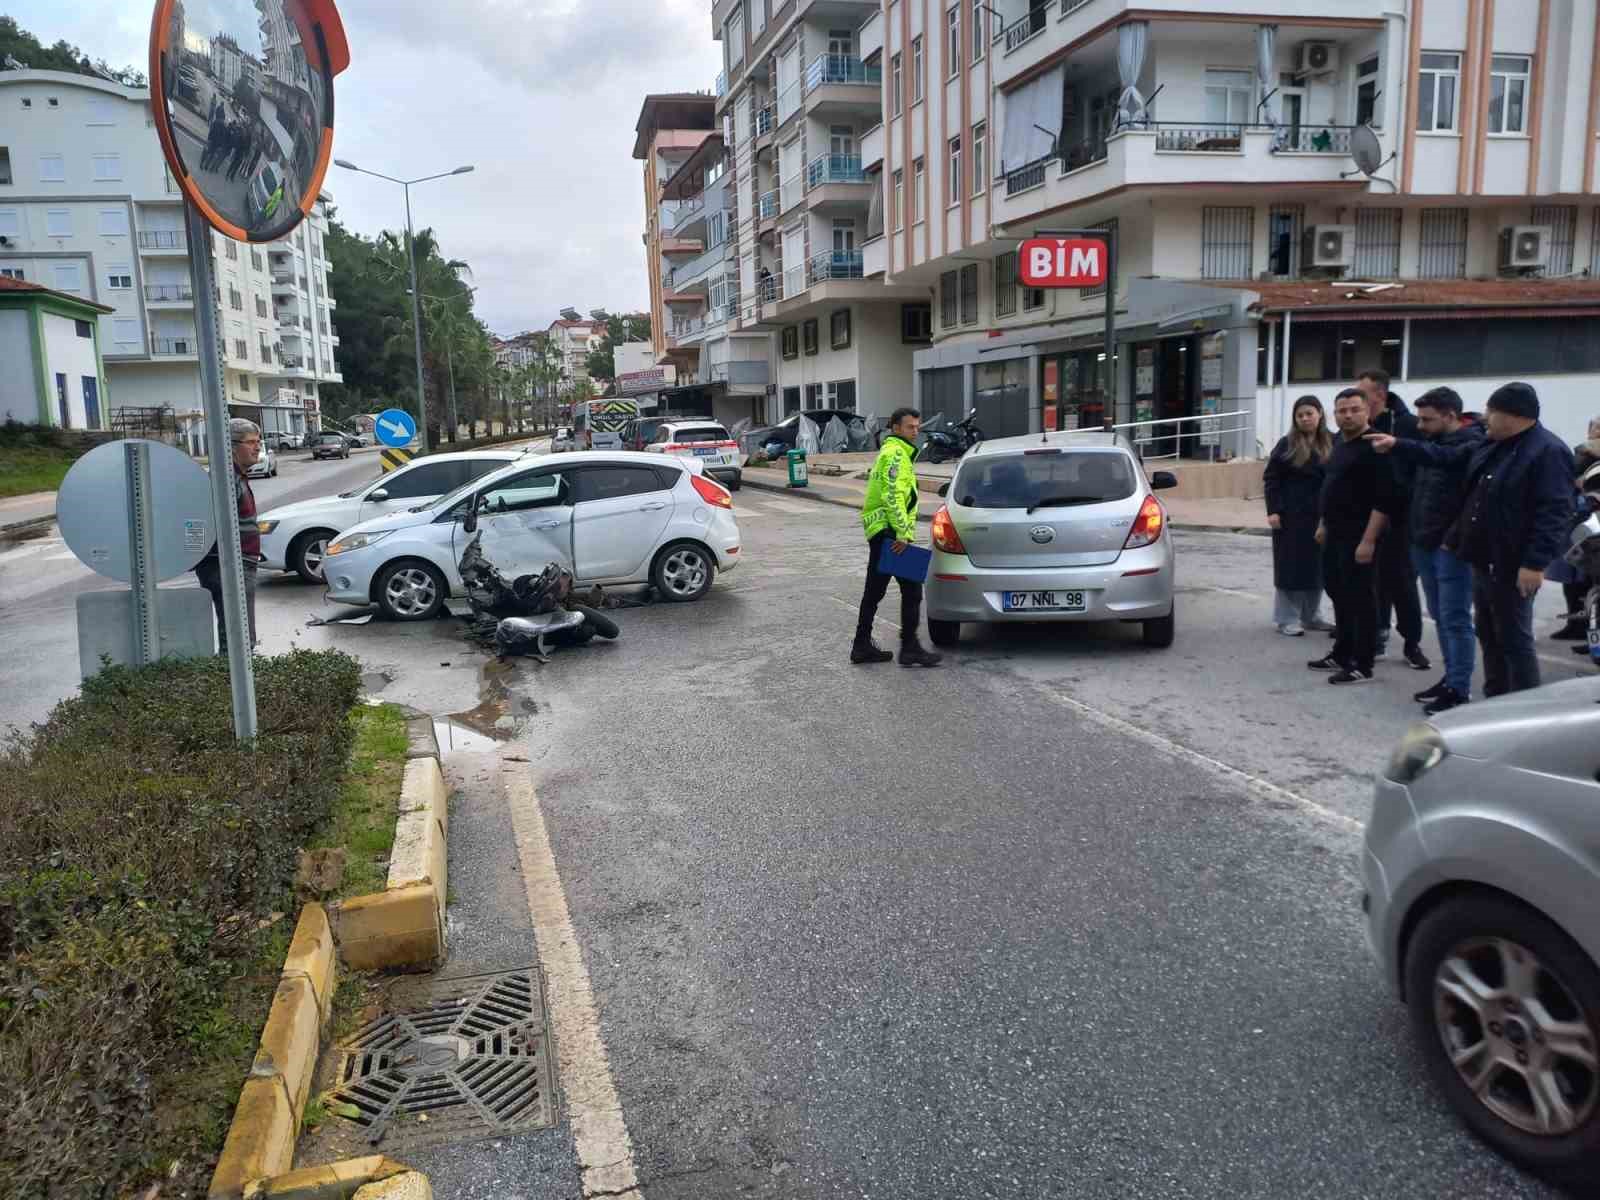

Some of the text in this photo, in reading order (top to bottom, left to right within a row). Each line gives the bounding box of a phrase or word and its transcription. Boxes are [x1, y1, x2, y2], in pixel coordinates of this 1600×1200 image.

[1029, 240, 1099, 278] BİM
[1012, 592, 1083, 606] 07 NNL 98
